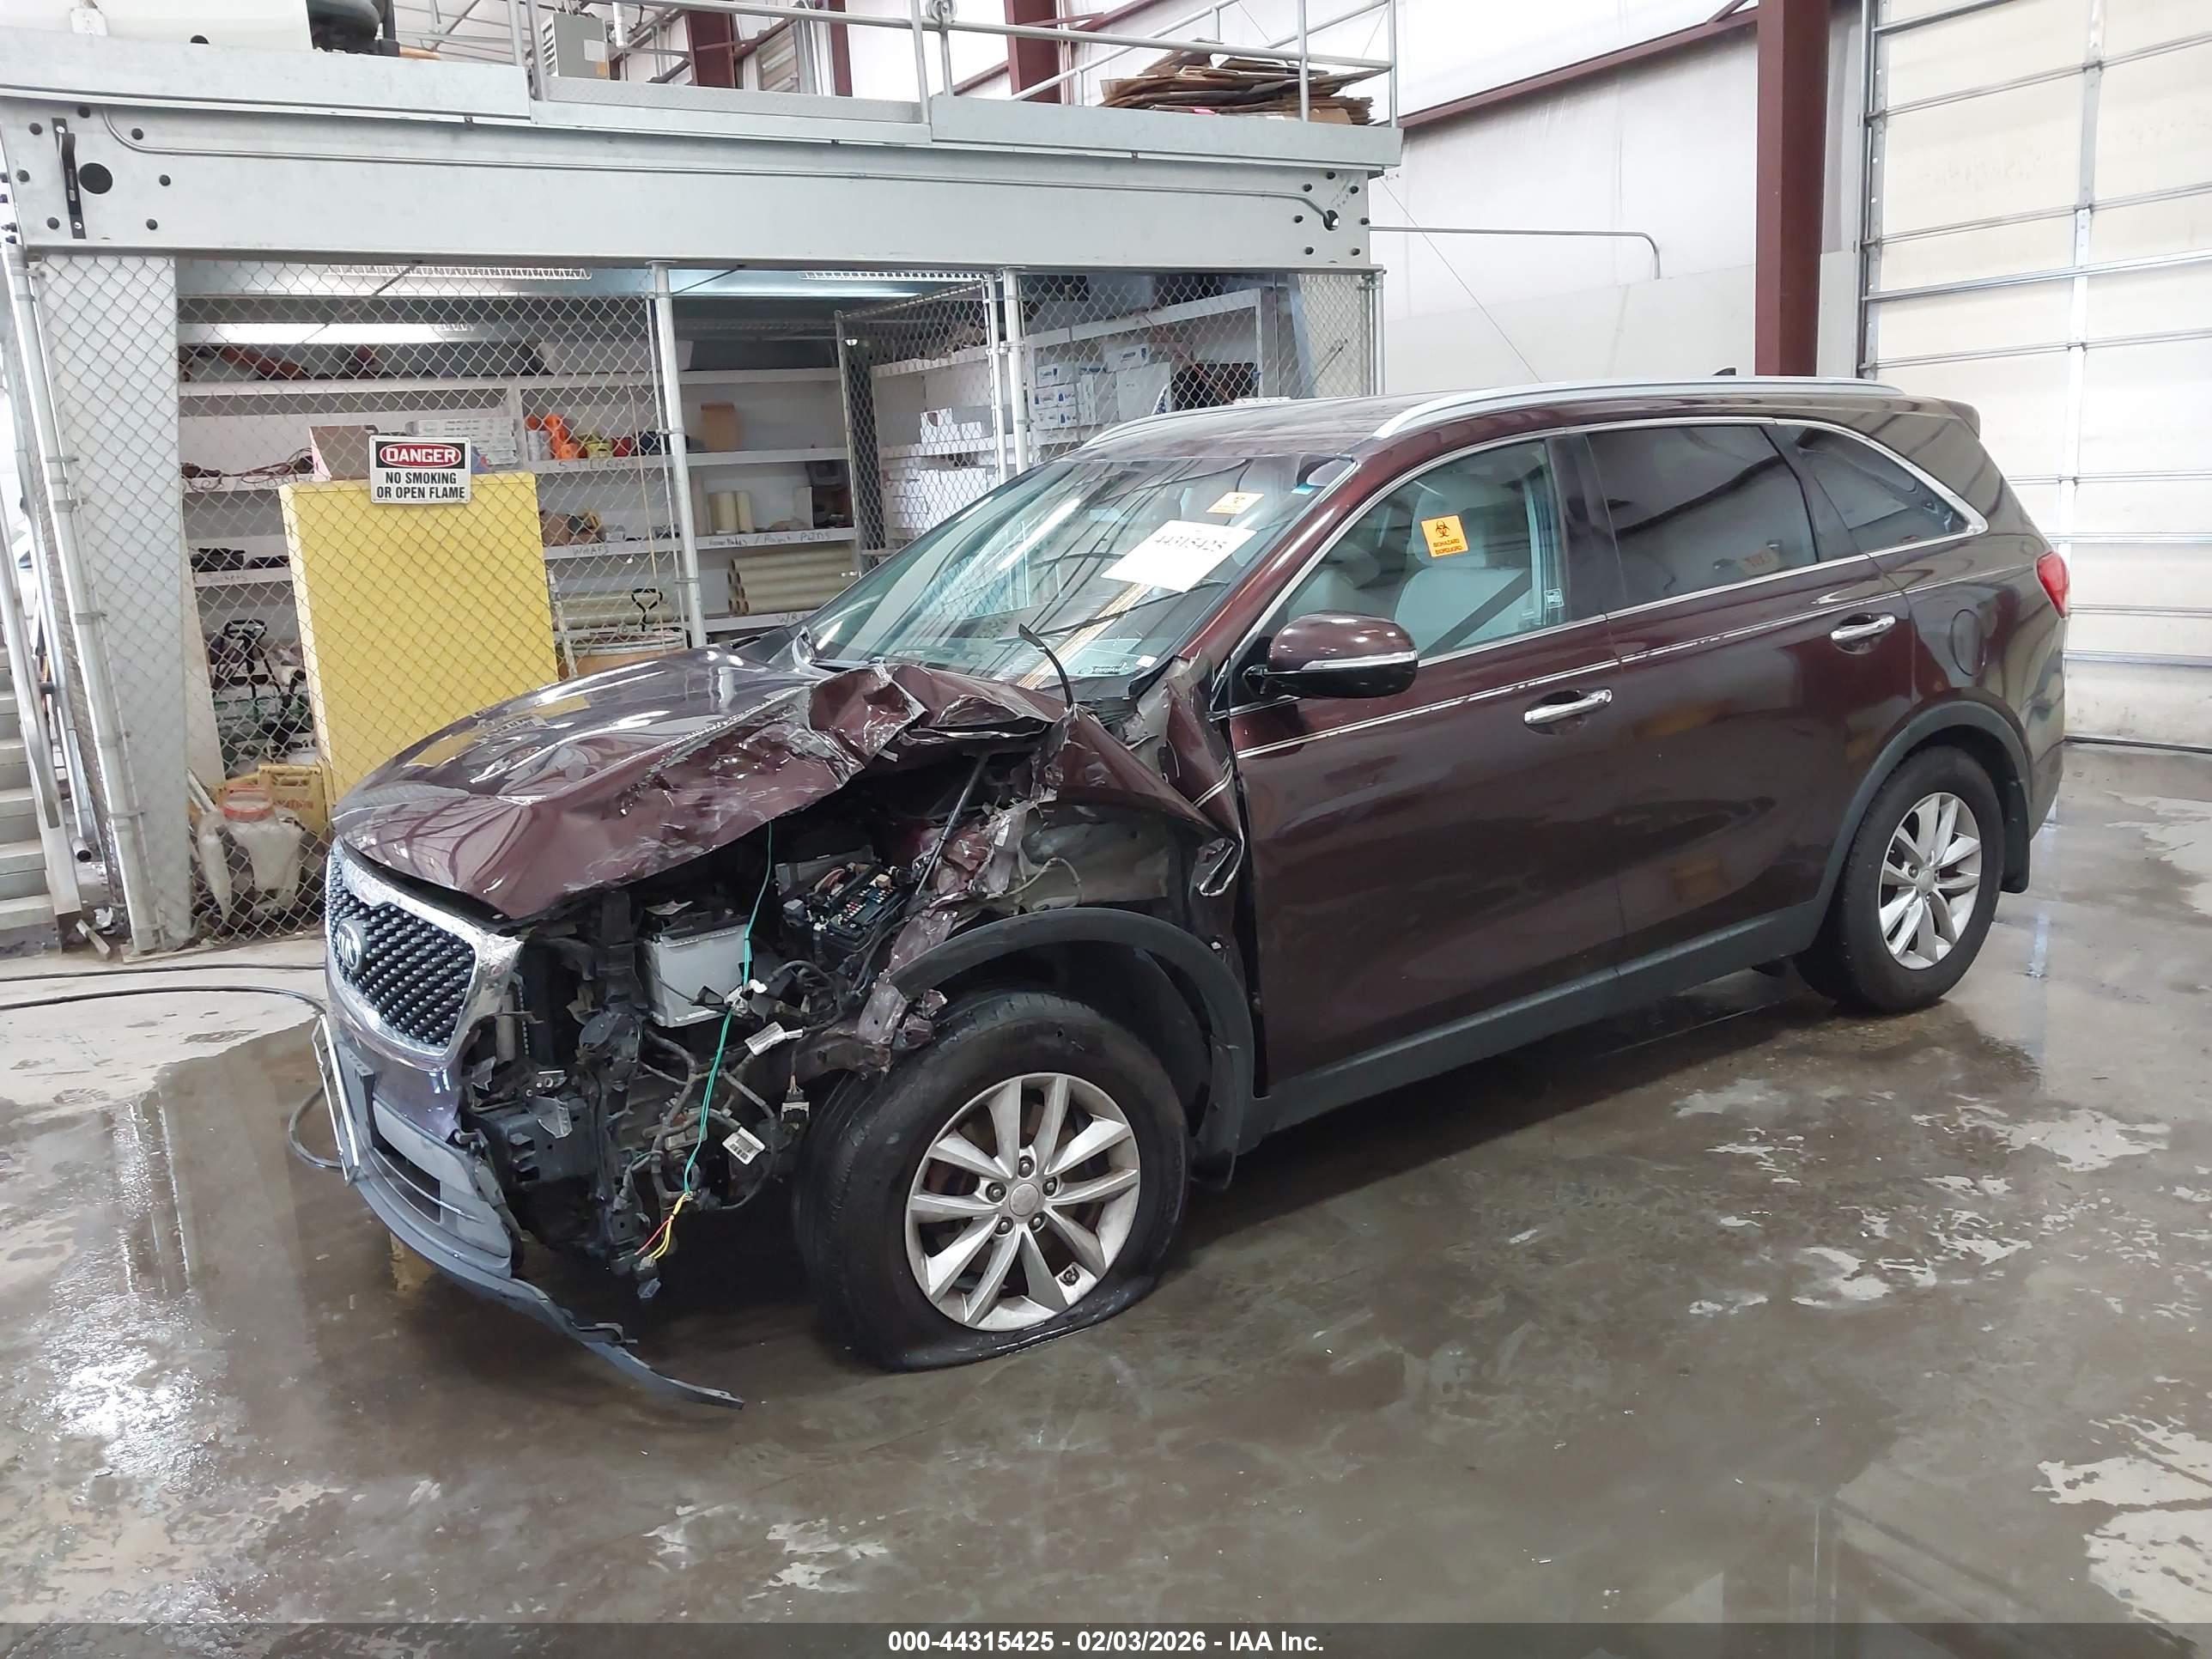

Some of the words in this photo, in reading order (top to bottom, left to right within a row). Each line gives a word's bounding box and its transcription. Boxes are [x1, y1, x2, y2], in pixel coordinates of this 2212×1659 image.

[386, 447, 456, 463] DANGER
[386, 471, 401, 483] NO
[405, 472, 457, 484] SMOKING
[377, 486, 392, 498] OR
[396, 486, 425, 499] OPEN
[429, 487, 465, 499] FLAME
